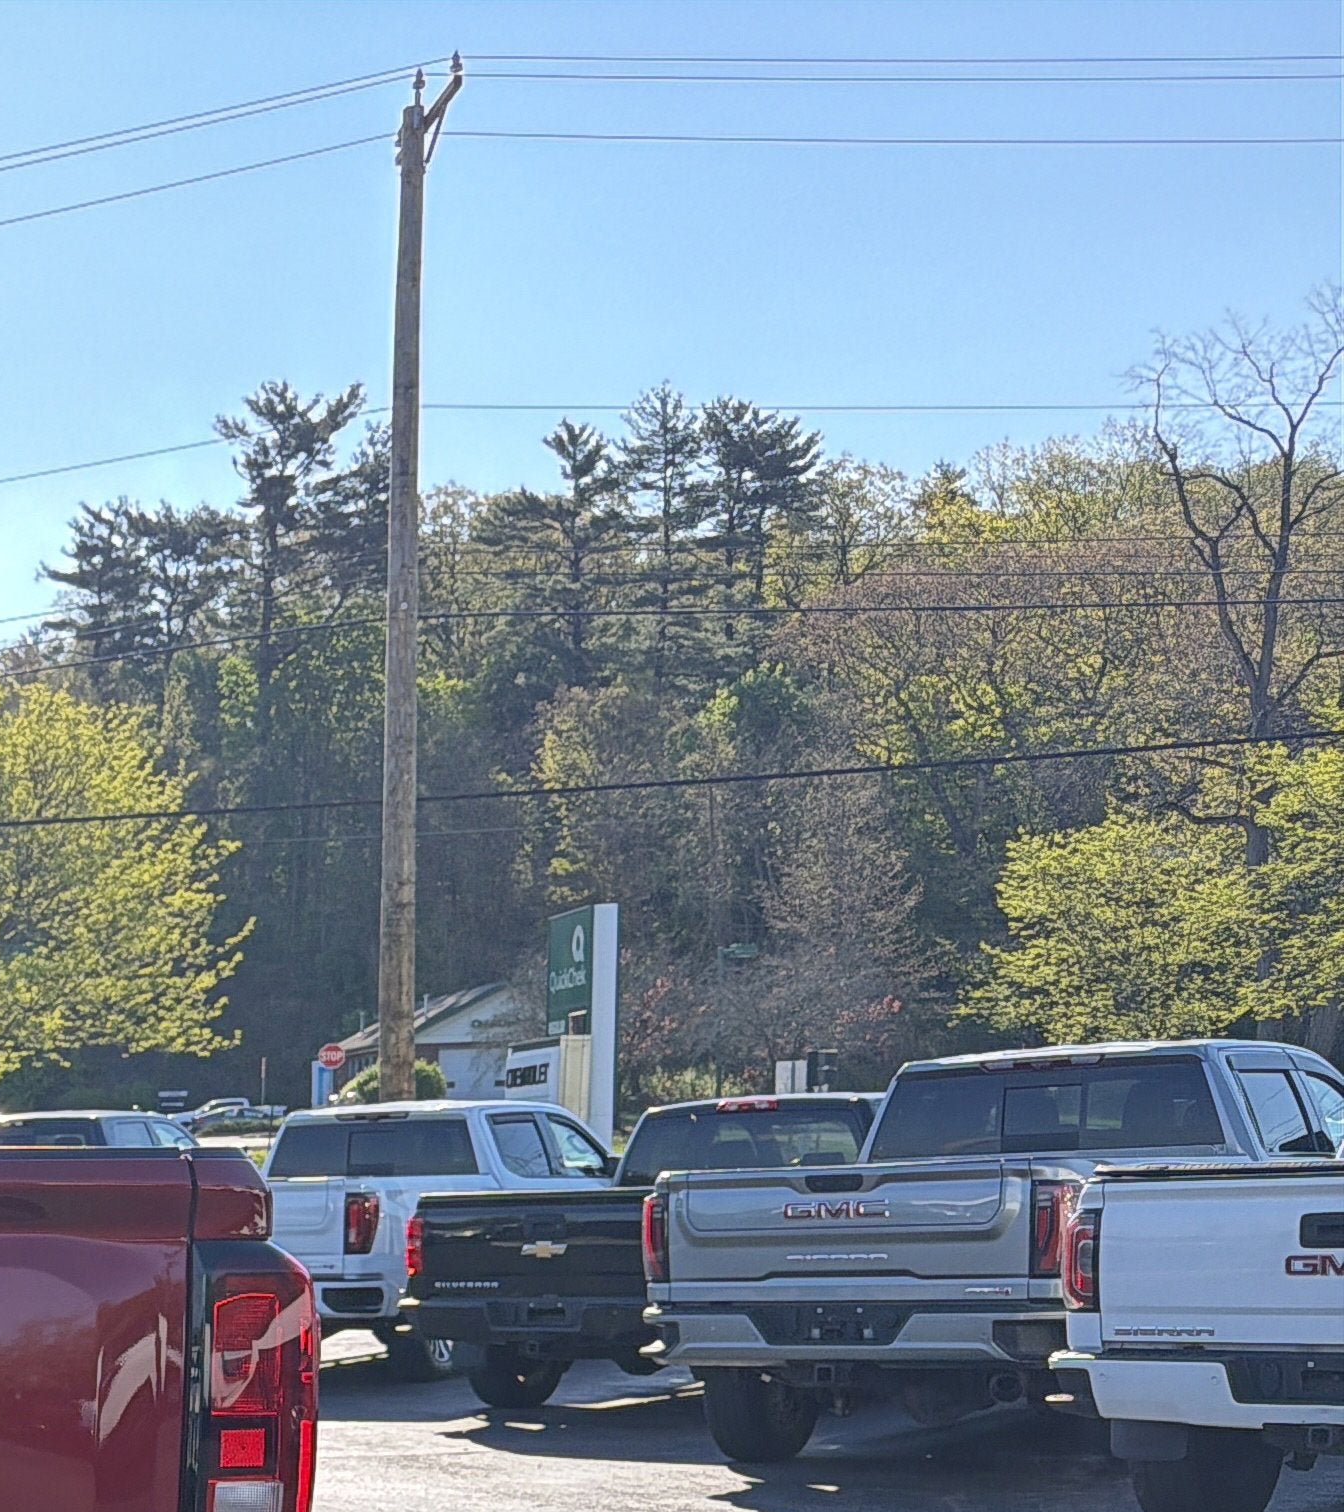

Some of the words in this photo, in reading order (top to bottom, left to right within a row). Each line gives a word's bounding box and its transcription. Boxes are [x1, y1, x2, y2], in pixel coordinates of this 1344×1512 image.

[320, 1050, 343, 1062] STOP
[783, 1199, 890, 1220] GMC
[1285, 1255, 1344, 1276] GM
[1114, 1326, 1216, 1338] SIERRA
